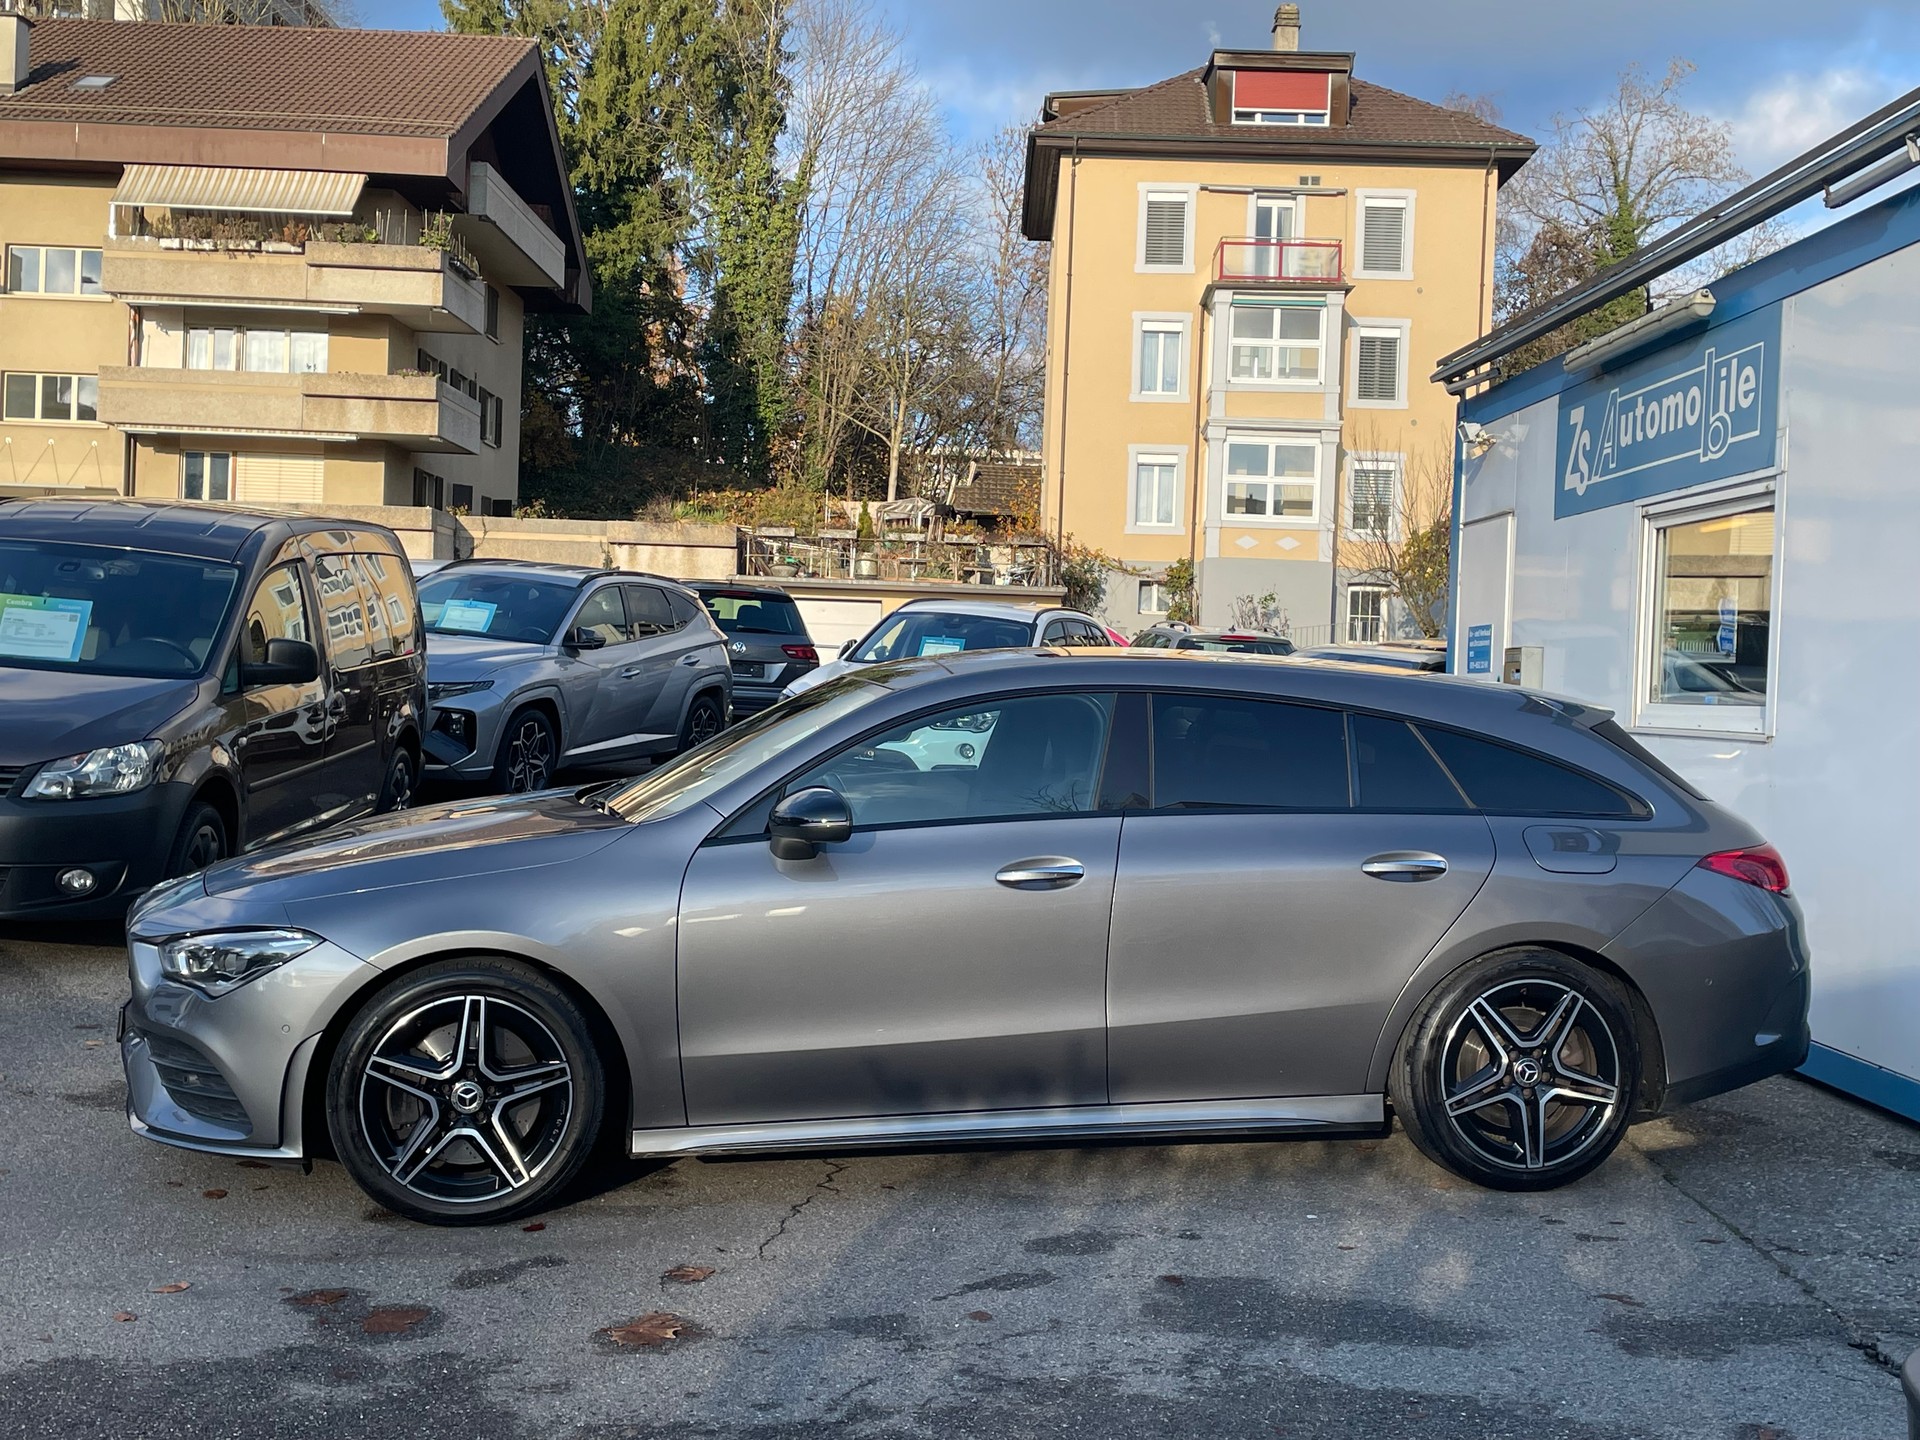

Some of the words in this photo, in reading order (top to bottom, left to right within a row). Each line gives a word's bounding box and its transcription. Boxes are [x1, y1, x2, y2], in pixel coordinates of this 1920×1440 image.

[1564, 405, 1591, 496] Zs
[1591, 347, 1757, 481] Automobile
[6, 598, 33, 607] Cembra
